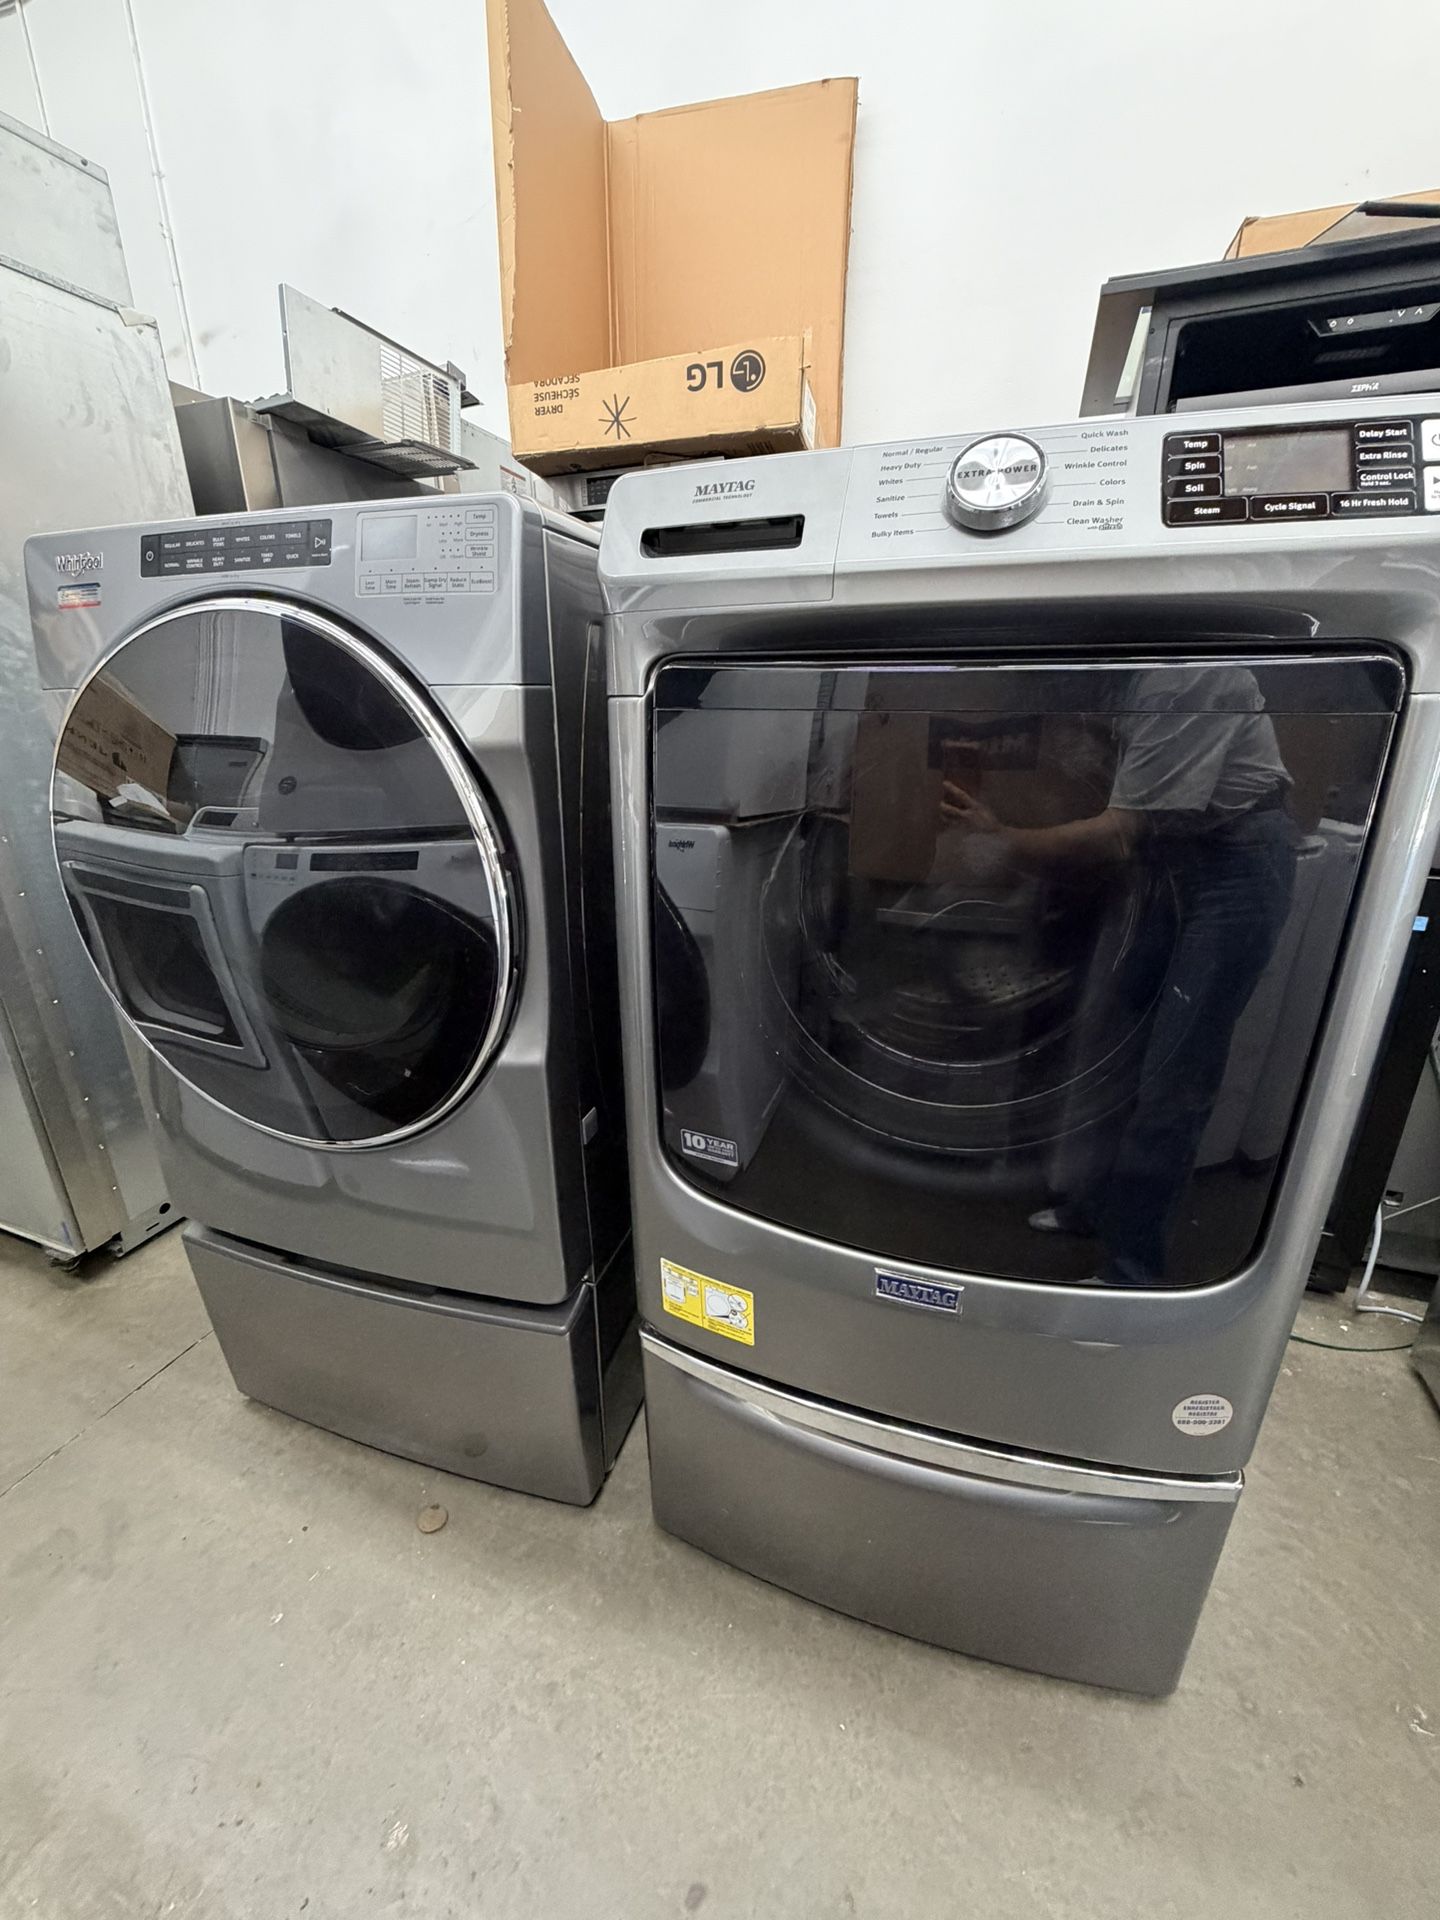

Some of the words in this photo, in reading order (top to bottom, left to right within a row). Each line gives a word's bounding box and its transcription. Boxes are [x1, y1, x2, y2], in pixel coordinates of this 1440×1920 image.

[686, 361, 723, 392] LG
[534, 387, 580, 402] SÉCHEUSE
[534, 404, 563, 416] DRYER
[1081, 431, 1104, 439] Quick
[1106, 429, 1128, 437] Wash
[1359, 430, 1384, 438] Delay
[1385, 428, 1407, 437] Start
[1090, 445, 1128, 453] Delicates
[1183, 439, 1208, 450] Temp
[882, 449, 909, 458] Normal
[915, 446, 943, 455] Regular
[1359, 452, 1382, 460] Extra
[1383, 451, 1408, 459] Rinse
[880, 464, 902, 472] Heavy
[904, 461, 921, 470] Duty
[1064, 461, 1095, 469] Wrinkle
[1097, 459, 1127, 468] Control
[1184, 460, 1206, 472] Spin
[957, 469, 992, 479] EXTRA
[1360, 472, 1392, 481] Control
[1394, 471, 1414, 480] Lock
[878, 478, 903, 486] Whites
[1099, 478, 1126, 486] Colors
[694, 479, 755, 498] MAYTAG
[1185, 483, 1204, 494] Soil
[876, 494, 905, 503] Sanitize
[1073, 499, 1095, 507] Drain
[1106, 498, 1125, 506] Spin
[1363, 499, 1386, 507] Fresh
[1388, 498, 1409, 506] Hold
[1194, 506, 1220, 515] Steam
[1264, 503, 1288, 513] Cycle
[1289, 502, 1316, 512] Signal
[874, 511, 898, 520] Towels
[1067, 517, 1089, 525] Clean
[1092, 516, 1123, 525] Washer
[871, 530, 892, 538] Bulky
[893, 528, 914, 537] Items
[55, 551, 104, 575] Whirlpool
[684, 1132, 706, 1149] 10
[706, 1138, 734, 1150] YEAR
[879, 1278, 957, 1308] MAYTAG
